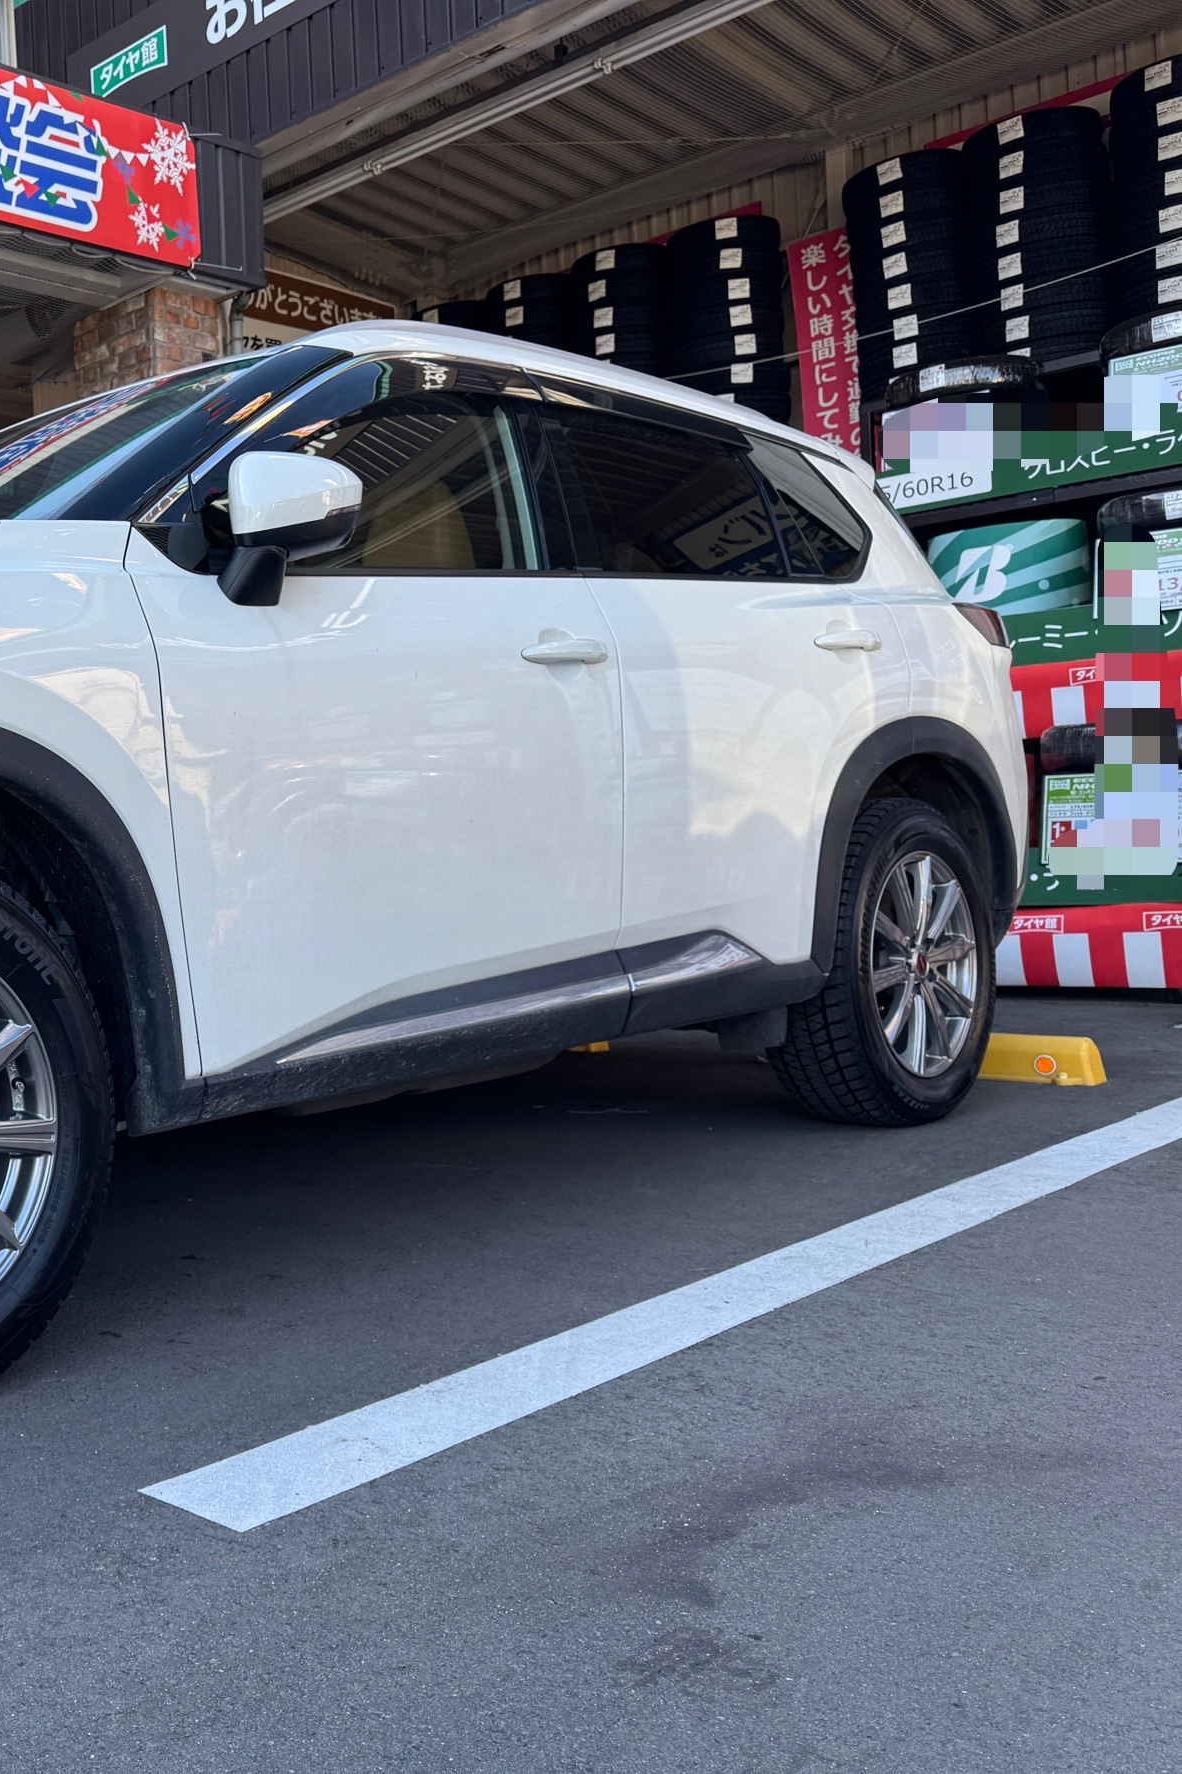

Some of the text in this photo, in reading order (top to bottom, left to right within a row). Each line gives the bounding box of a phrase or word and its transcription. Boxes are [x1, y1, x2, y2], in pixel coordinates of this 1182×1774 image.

[99, 37, 159, 90] タイヤ館
[1013, 917, 1058, 930] タイヤ館
